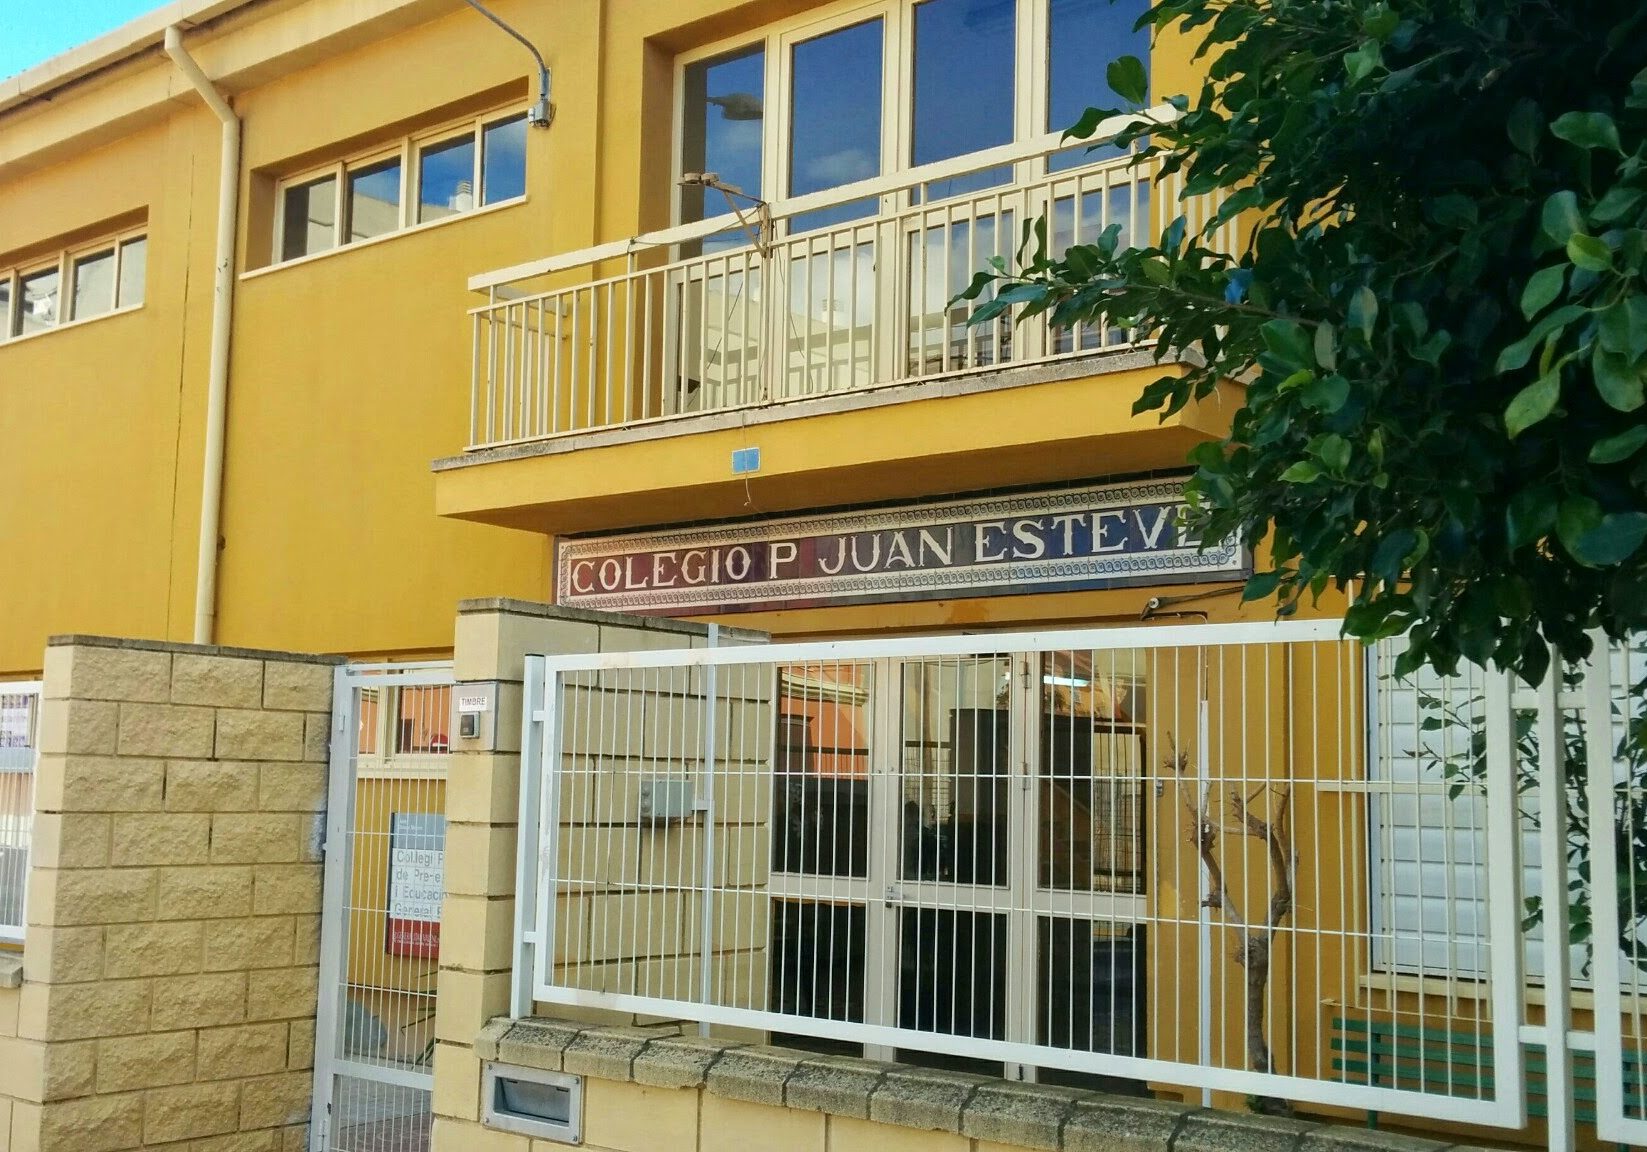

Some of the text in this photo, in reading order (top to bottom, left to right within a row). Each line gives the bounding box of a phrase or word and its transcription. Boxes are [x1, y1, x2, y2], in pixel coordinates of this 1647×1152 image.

[571, 545, 752, 593] COLEGIO
[768, 541, 798, 580] P
[817, 526, 954, 575] JUAN
[461, 697, 486, 706] TIMBRE
[396, 868, 408, 881] de
